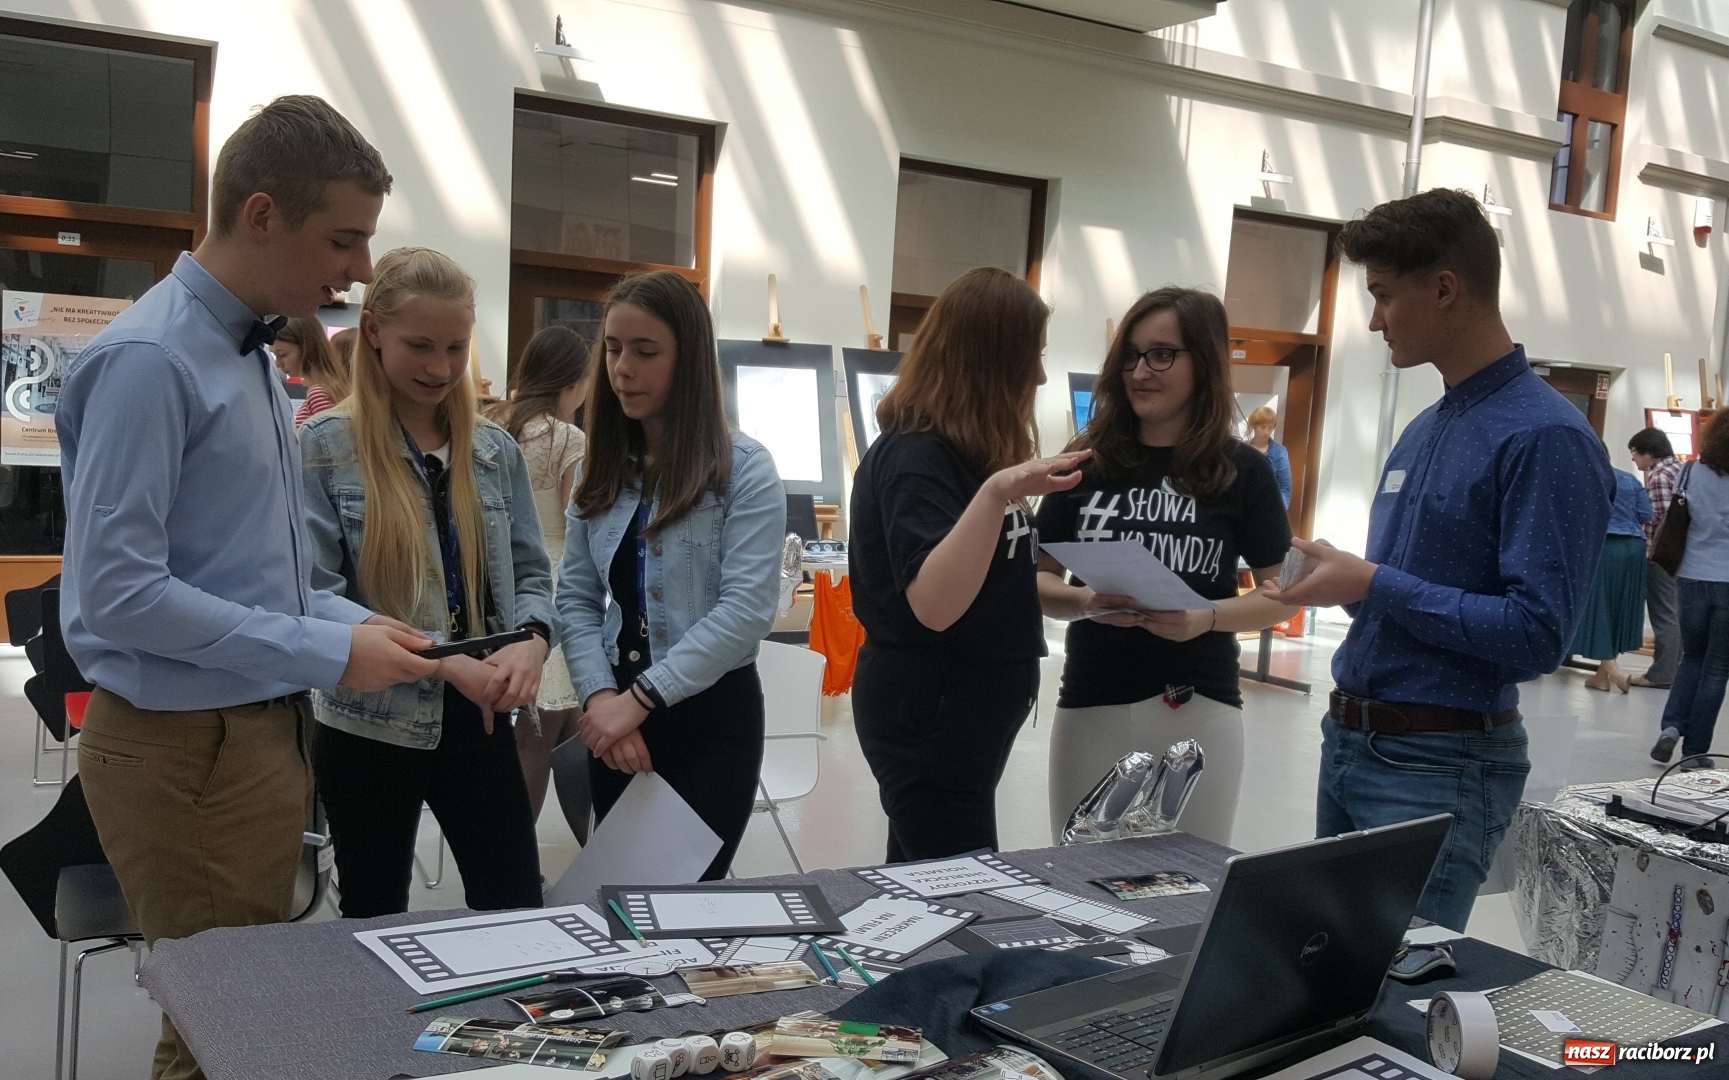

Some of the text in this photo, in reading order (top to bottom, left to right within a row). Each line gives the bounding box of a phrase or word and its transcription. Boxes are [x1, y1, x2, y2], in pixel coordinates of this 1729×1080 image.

[1122, 487, 1197, 523] SŁOWA
[903, 865, 969, 878] HOLMESA
[910, 871, 988, 884] SHERLOCKA
[928, 877, 999, 891] PRZYGODY
